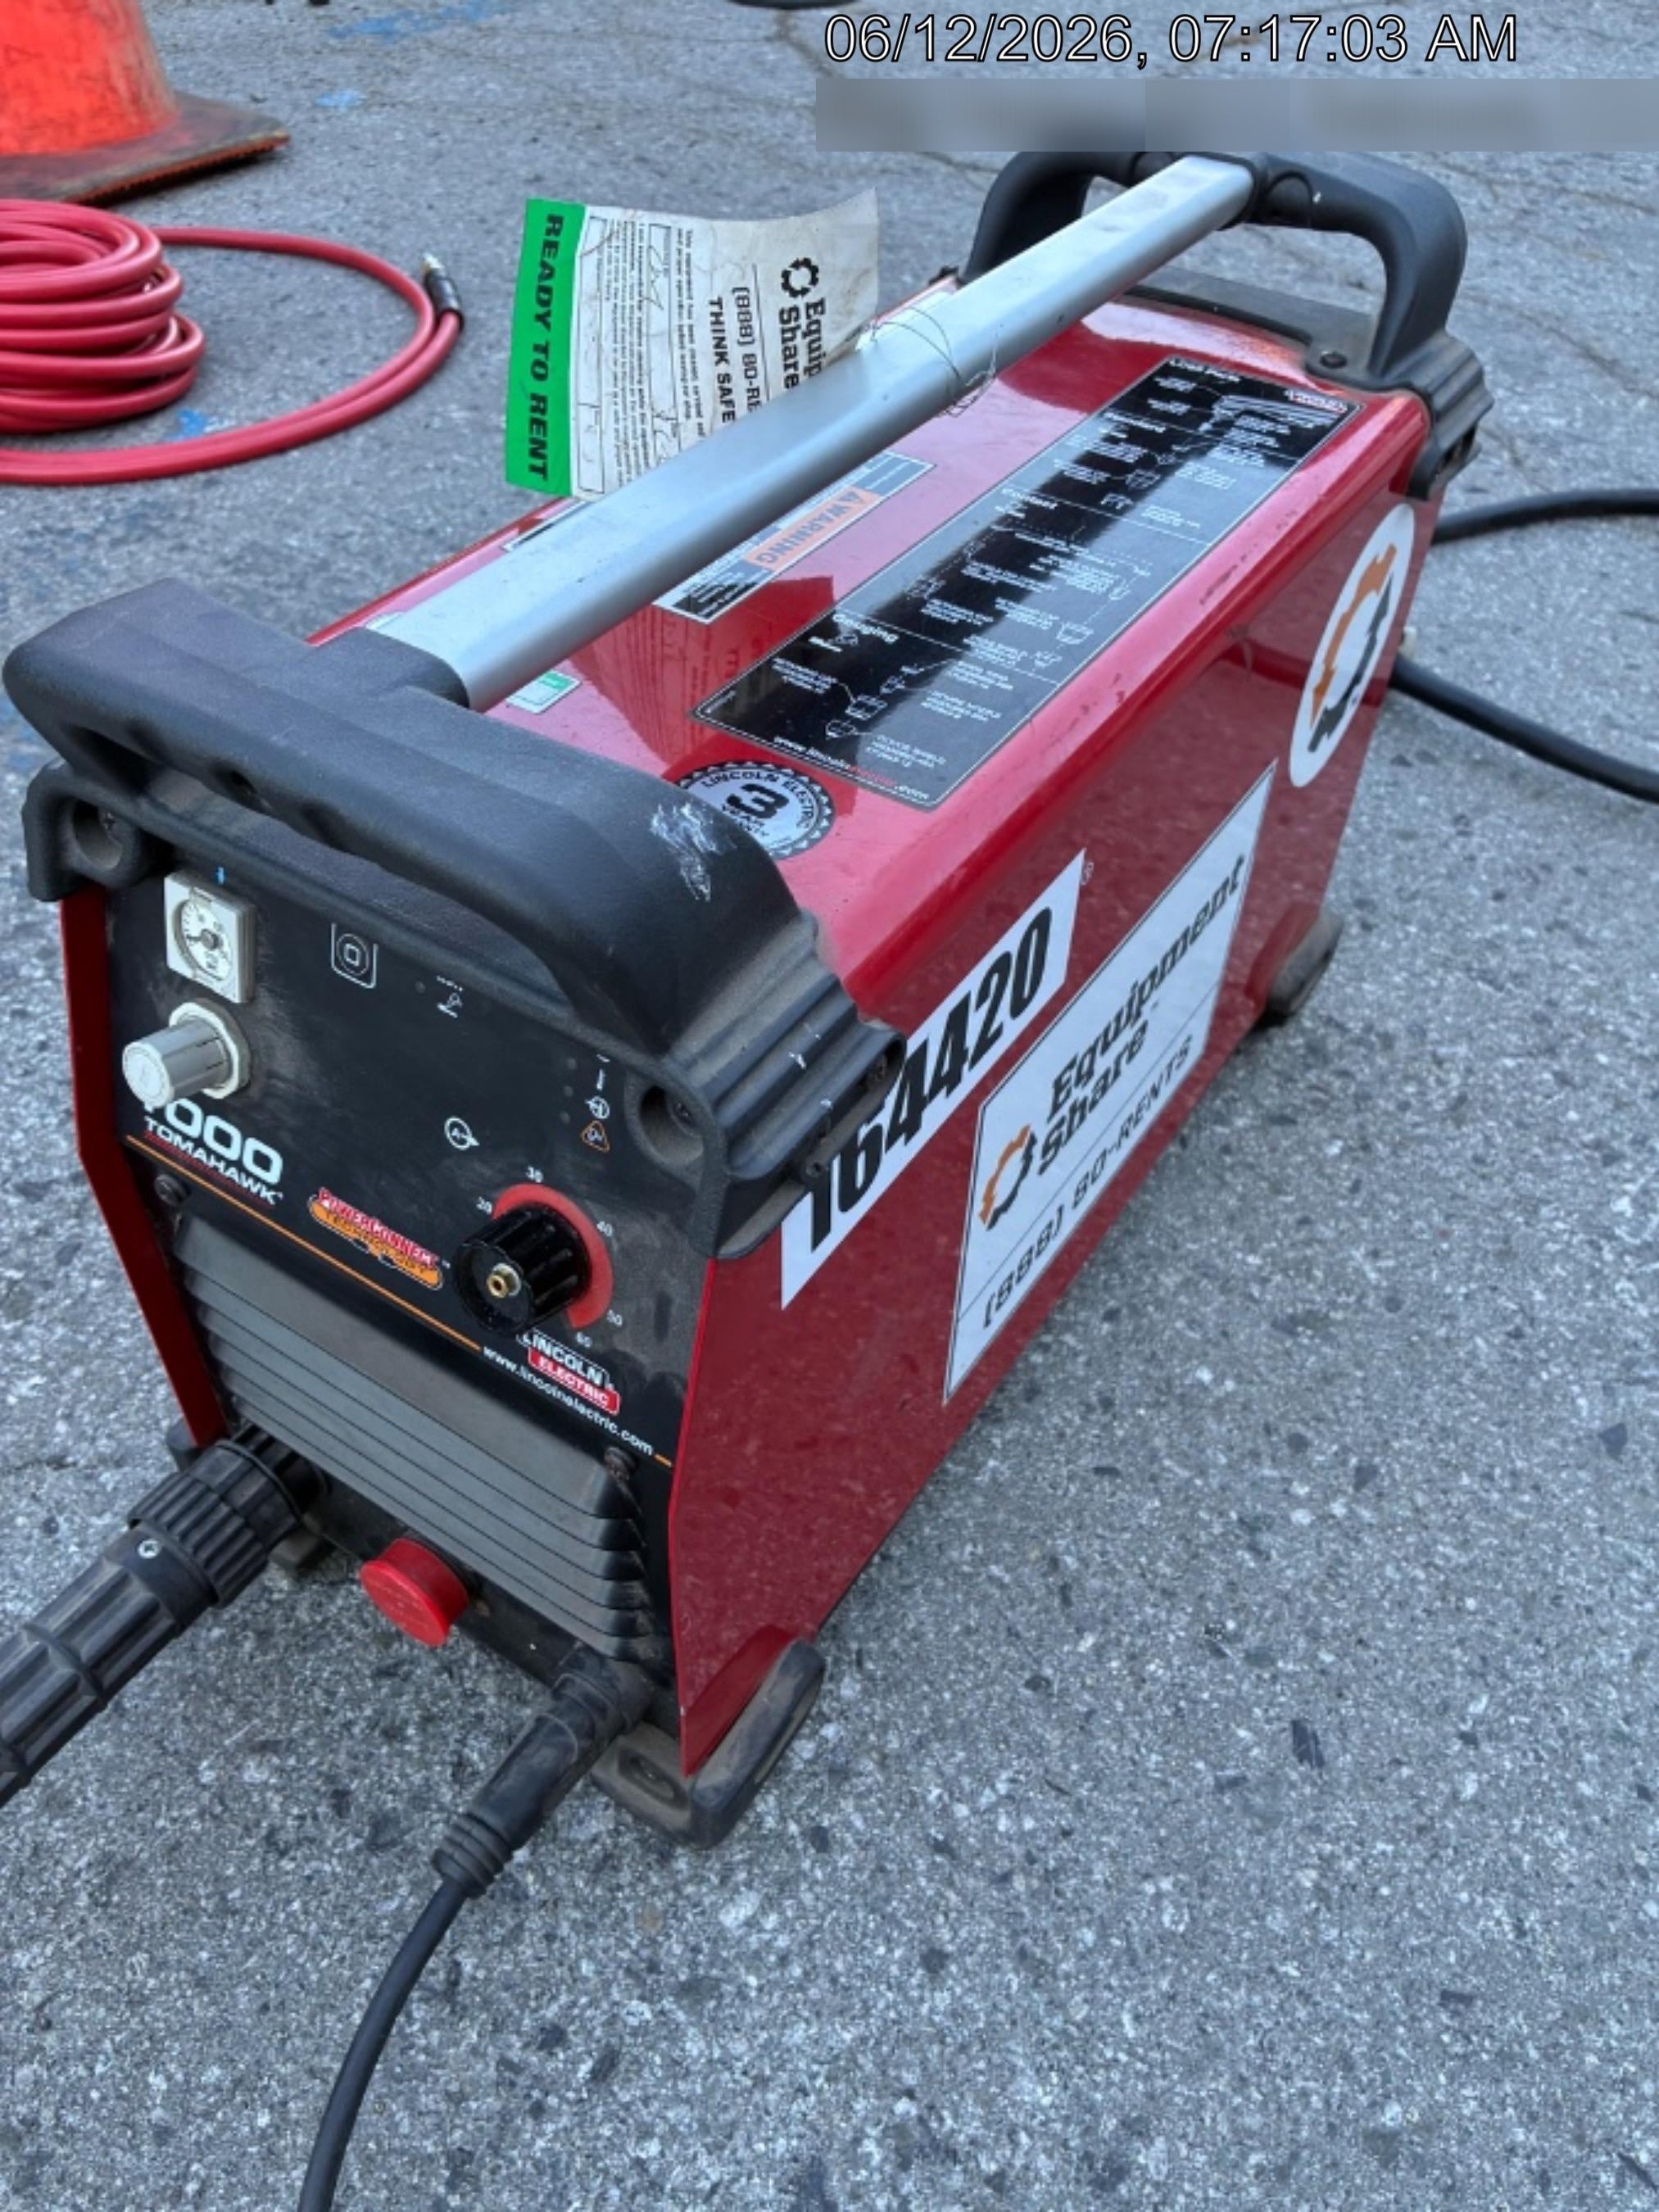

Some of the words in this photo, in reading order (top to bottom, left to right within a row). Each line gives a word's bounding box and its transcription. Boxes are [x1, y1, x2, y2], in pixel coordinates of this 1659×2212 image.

[534, 214, 564, 332] READY
[530, 340, 550, 382] TO
[709, 297, 730, 366] THINK
[779, 305, 801, 389] Share
[717, 373, 736, 423] SAFE
[528, 392, 550, 482] RENT
[755, 501, 846, 564] WARNING
[700, 770, 780, 787] LINCOLN
[726, 783, 790, 818] 3
[1047, 854, 1245, 1123] Equipment
[807, 906, 1052, 1253] 164420
[1038, 1019, 1149, 1175] Share
[144, 1099, 283, 1185] 000
[1072, 1034, 1193, 1210] 80-RENTS
[144, 1116, 277, 1205] TOMAHAWK
[525, 1165, 544, 1183] 30
[596, 1221, 613, 1237] 40
[522, 1332, 604, 1386] LINCOLN
[538, 1357, 610, 1407] ELECTRIC
[483, 1345, 655, 1457] www.lincolnelectric.com
